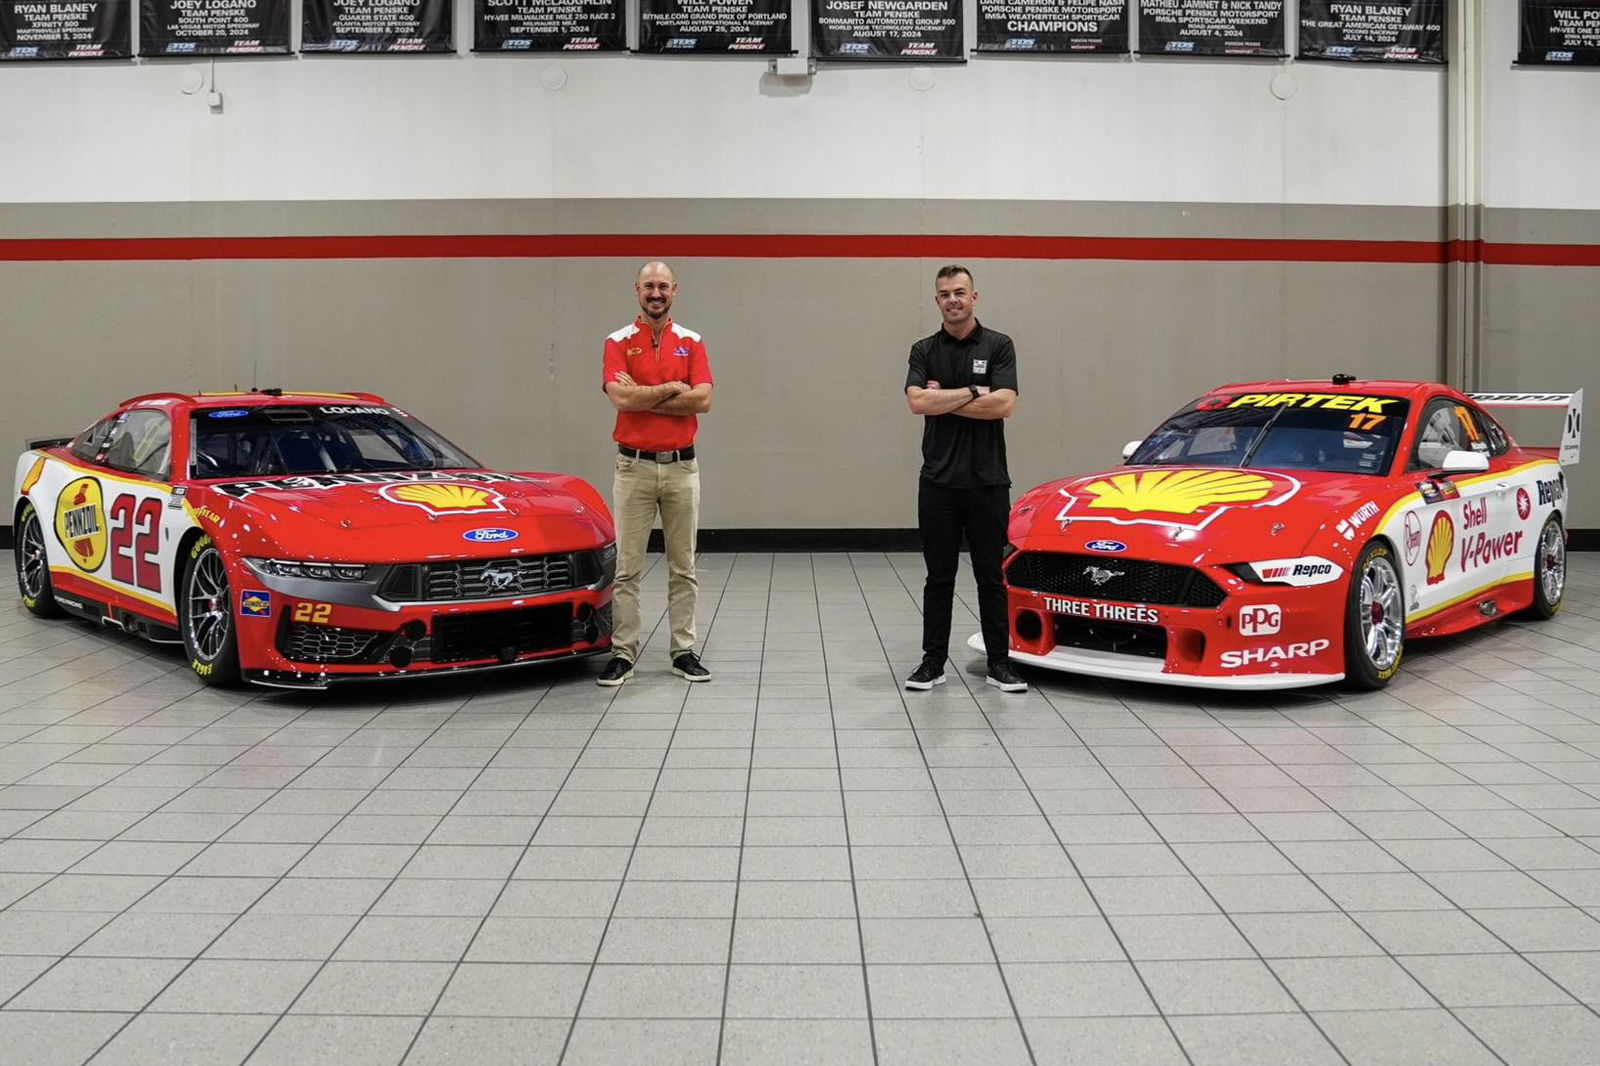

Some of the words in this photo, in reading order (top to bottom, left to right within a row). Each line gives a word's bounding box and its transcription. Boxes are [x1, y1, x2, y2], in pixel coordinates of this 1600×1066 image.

[14, 5, 47, 14] RYAN
[50, 3, 98, 13] BLANEY
[170, 0, 202, 9] JOEY
[205, 0, 257, 9] LOGANO
[517, 6, 545, 14] TEAM
[826, 1, 865, 10] JOSEF
[868, 1, 948, 10] NEWGARDEN
[1025, 6, 1060, 14] PENSKE
[1140, 0, 1179, 8] MATHIEU
[1181, 0, 1219, 9] JAMINET
[1222, 1, 1228, 9] &
[1230, 1, 1251, 10] NICK
[1253, 1, 1282, 10] TANDY
[1330, 4, 1362, 14] RYAN
[1365, 6, 1412, 16] BLANEY
[24, 14, 50, 22] TEAM
[53, 13, 88, 21] PENSKE
[181, 9, 208, 17] TEAM
[211, 9, 246, 17] PENSKE
[1143, 8, 1183, 16] PORSCHE
[1185, 9, 1219, 17] PENSKE
[1221, 10, 1280, 18] MOTORSPORT
[1340, 14, 1366, 22] TEAM
[1553, 10, 1581, 19] WILL
[1583, 10, 1600, 20] PO
[1007, 21, 1098, 32] CHAMPIONS
[1345, 22, 1386, 30] AMERICAN
[215, 29, 228, 37] 20,
[1227, 393, 1399, 413] PIRTEK
[320, 406, 390, 415] LOGANO
[1348, 413, 1387, 430] 17
[1463, 497, 1487, 530] Shell
[63, 504, 101, 539] PENNZOIL
[110, 493, 163, 593] 22
[1460, 530, 1523, 573] V-Power
[1292, 564, 1332, 577] Repco
[294, 602, 332, 623] 22
[1044, 597, 1090, 616] THREE
[1093, 603, 1158, 623] THREES
[1242, 608, 1280, 633] PPG
[1220, 638, 1330, 668] SHARP
